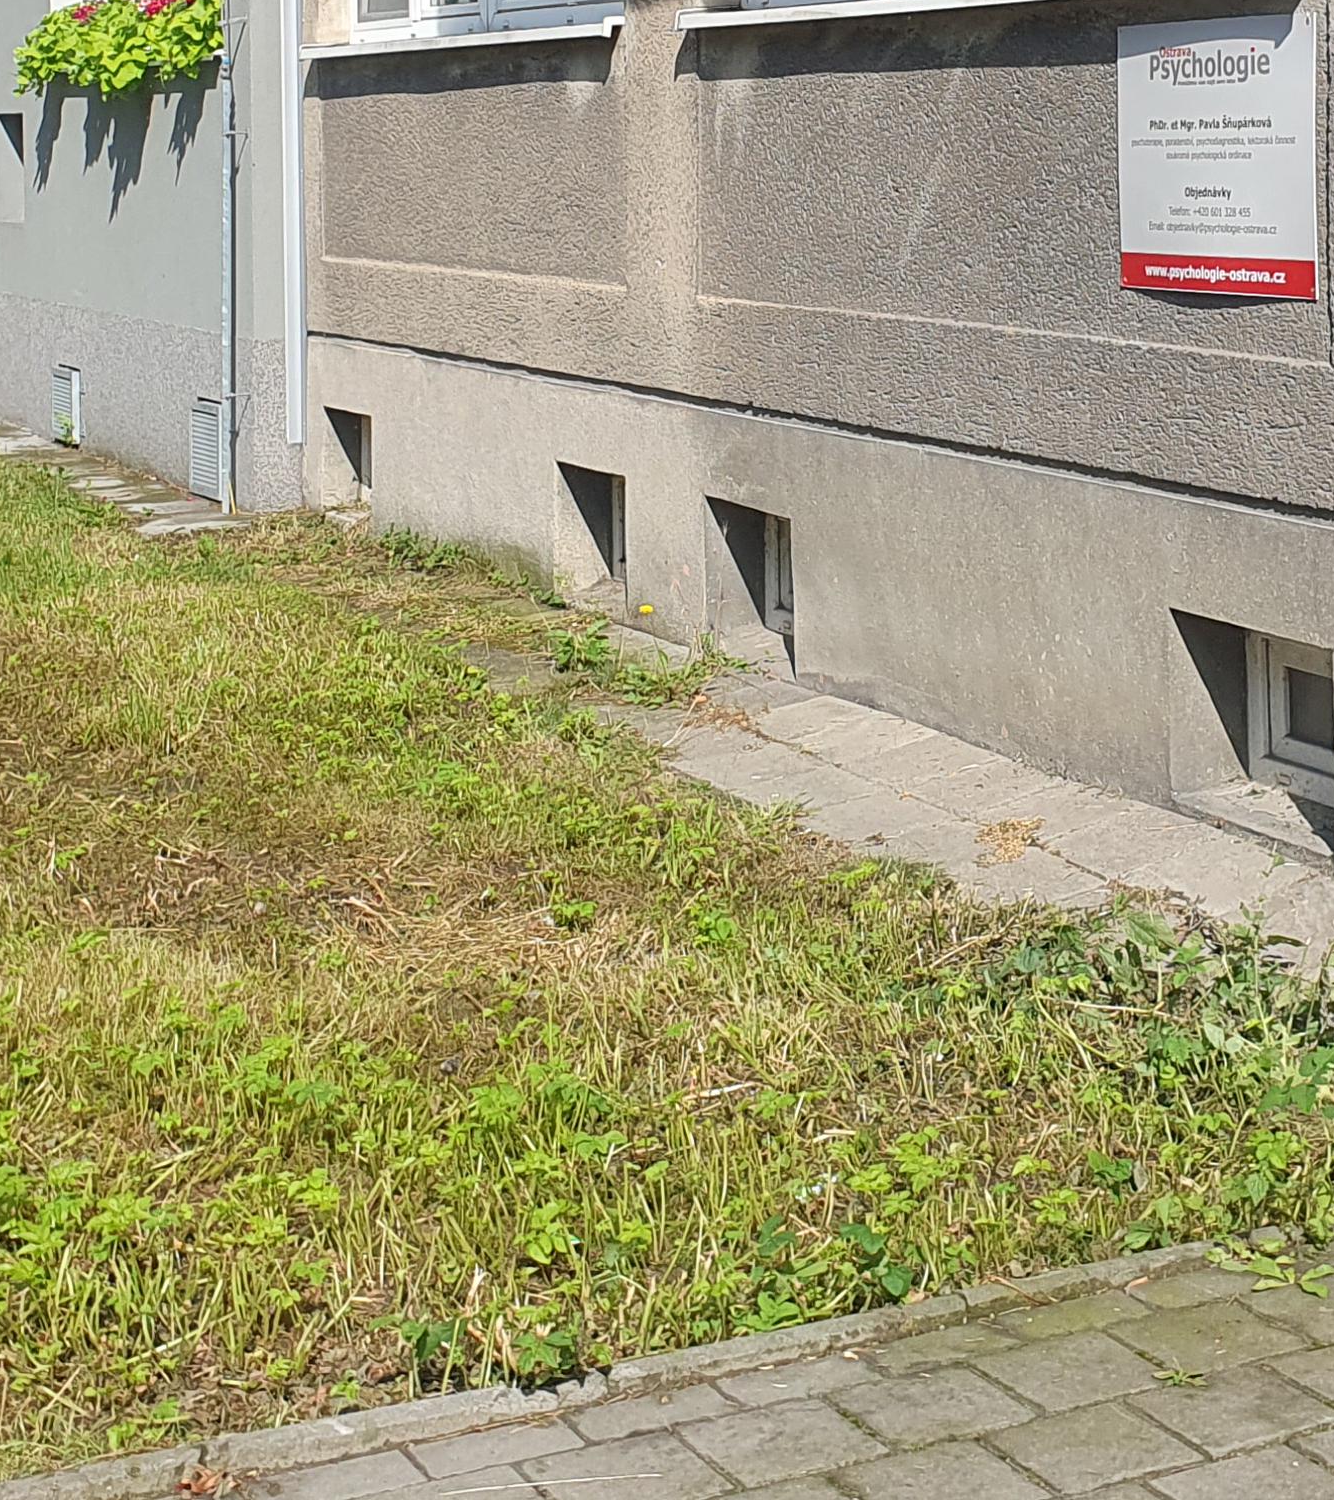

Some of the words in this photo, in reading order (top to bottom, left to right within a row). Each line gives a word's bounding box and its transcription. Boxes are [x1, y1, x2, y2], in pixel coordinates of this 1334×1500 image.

[1159, 46, 1191, 58] Ostrava
[1150, 47, 1270, 86] Psychologie
[1149, 120, 1169, 131] PhDr.
[1171, 120, 1179, 130] et
[1180, 119, 1197, 132] Mgr.
[1199, 118, 1220, 130] Pavla
[1222, 114, 1272, 130] Šňupárková
[1184, 186, 1232, 200] Objednávky
[1145, 264, 1286, 284] www.psychologie-ostrava.cz
